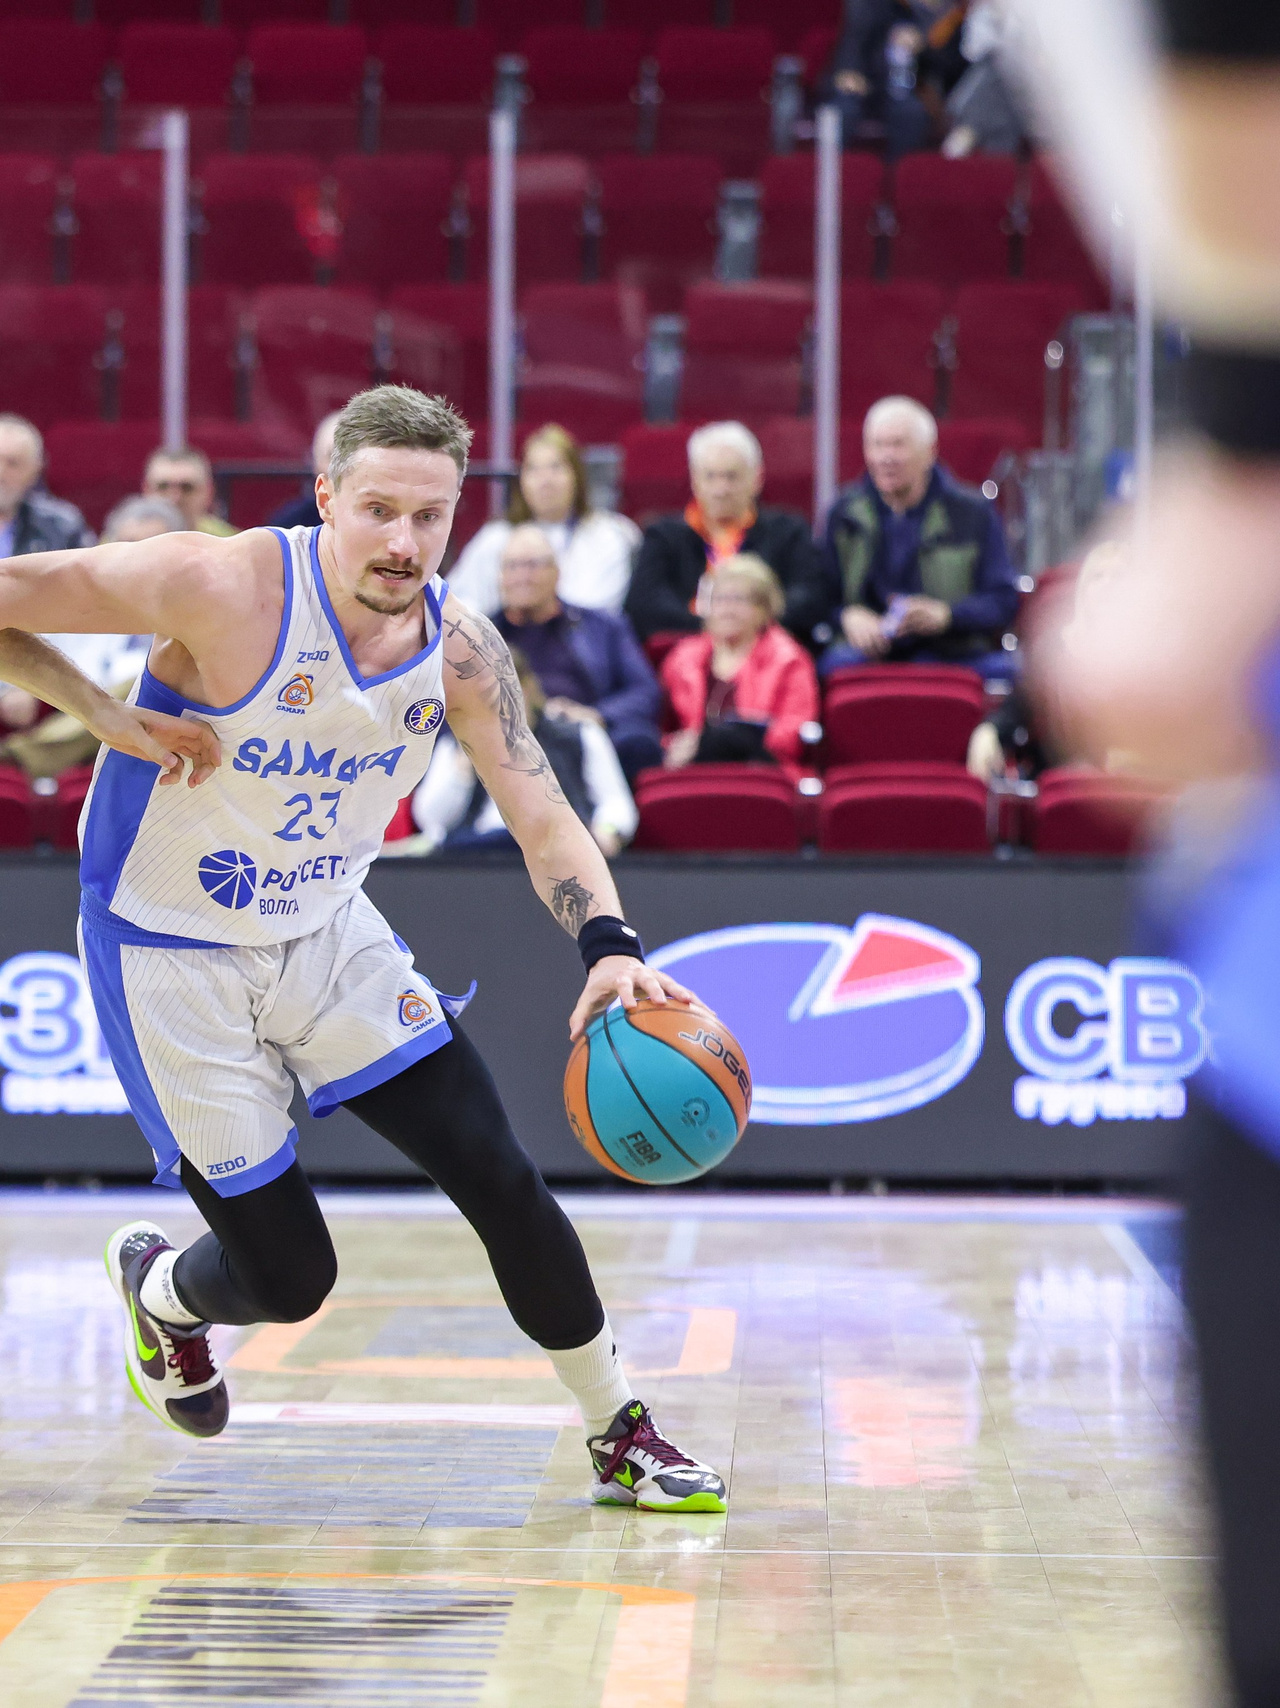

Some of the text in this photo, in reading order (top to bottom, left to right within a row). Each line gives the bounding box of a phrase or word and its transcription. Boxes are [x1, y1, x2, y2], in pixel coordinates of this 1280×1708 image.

[273, 788, 344, 841] 23
[261, 855, 349, 892] РОСЕТ
[259, 898, 300, 916] ВОЛГА
[626, 1130, 662, 1165] FIBA
[206, 1155, 247, 1176] ZEDO
